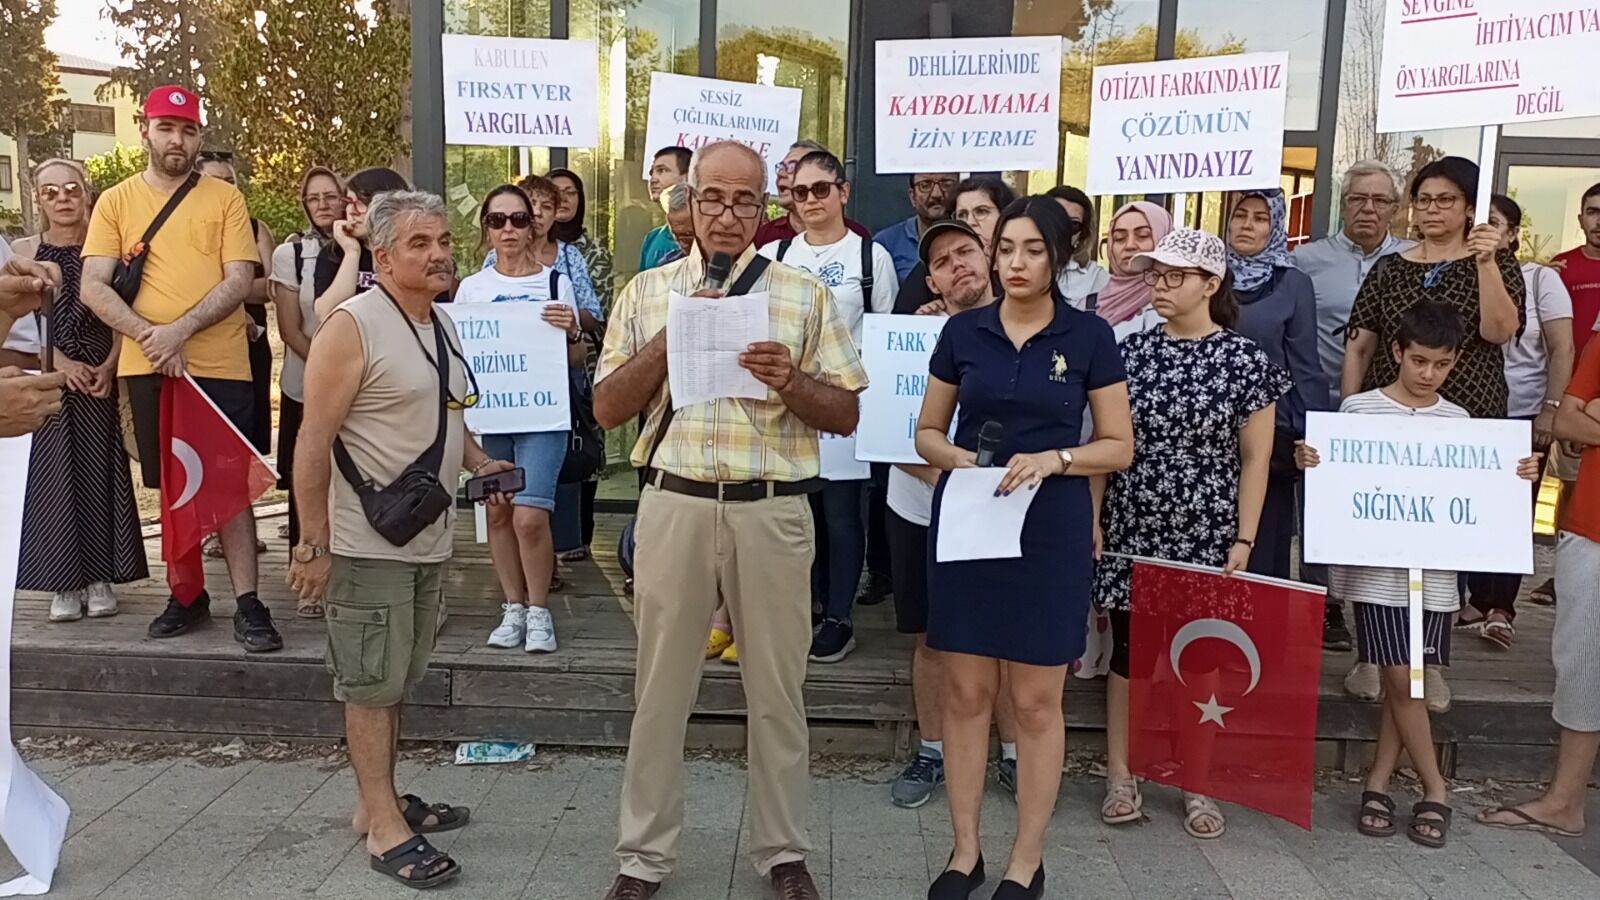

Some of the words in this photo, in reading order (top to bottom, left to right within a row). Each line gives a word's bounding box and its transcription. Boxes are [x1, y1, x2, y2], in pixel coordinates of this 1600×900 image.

[1475, 11, 1573, 46] İHTİYACIM
[474, 48, 549, 70] KABULLEN
[908, 49, 1040, 77] DEHLİZLERİMDE
[457, 81, 527, 100] FIRSAT
[531, 84, 572, 102] VER
[1100, 71, 1155, 101] OTİZM
[1160, 64, 1281, 98] FARKINDAYIZ
[699, 88, 743, 108] SESSİZ
[888, 92, 1050, 116] KAYBOLMAMA
[1515, 85, 1564, 115] DEĞİL
[464, 111, 573, 136] YARGILAMA
[672, 105, 780, 134] ÇIĞLIKLARIMIZI
[1121, 107, 1252, 143] ÇÖZÜMÜN
[908, 127, 953, 149] İZİN
[961, 130, 1037, 148] VERME
[1115, 149, 1253, 182] YANINDAYIZ
[458, 315, 500, 340] TİZM
[887, 331, 926, 352] FARK
[473, 349, 528, 374] BİZİMLE
[534, 390, 558, 407] OL
[1329, 438, 1502, 470] FIRTINALARIMA
[1352, 486, 1435, 523] SIĞINAK
[1449, 496, 1477, 525] OL
